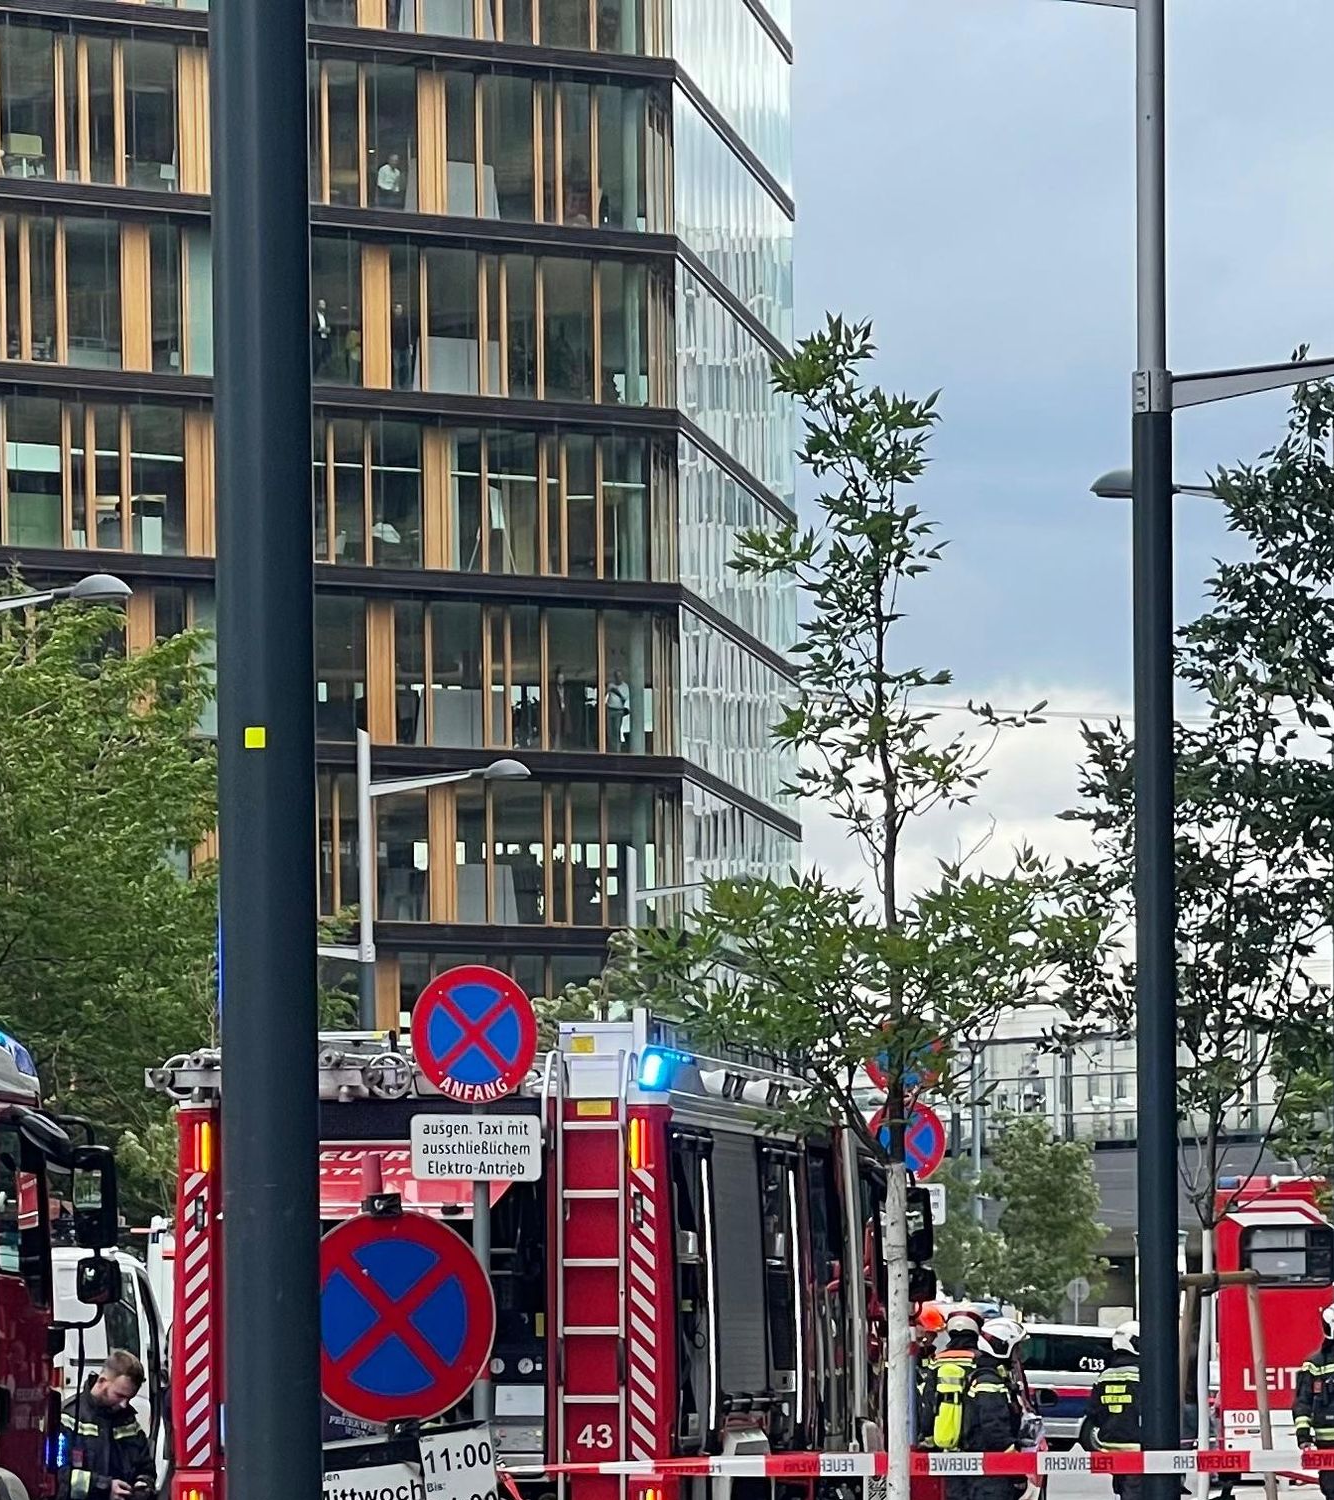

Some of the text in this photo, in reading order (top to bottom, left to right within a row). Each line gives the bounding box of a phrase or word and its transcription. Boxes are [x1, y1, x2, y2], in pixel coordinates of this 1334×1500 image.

[439, 1076, 509, 1101] ANFANG
[423, 1121, 529, 1138] ausgen. Taxi mit
[422, 1141, 530, 1156] ausschließlichem
[428, 1160, 525, 1176] Elektro-Antrieb
[1231, 1412, 1255, 1424] 100
[577, 1424, 613, 1449] 43
[424, 1441, 492, 1474] 11:00
